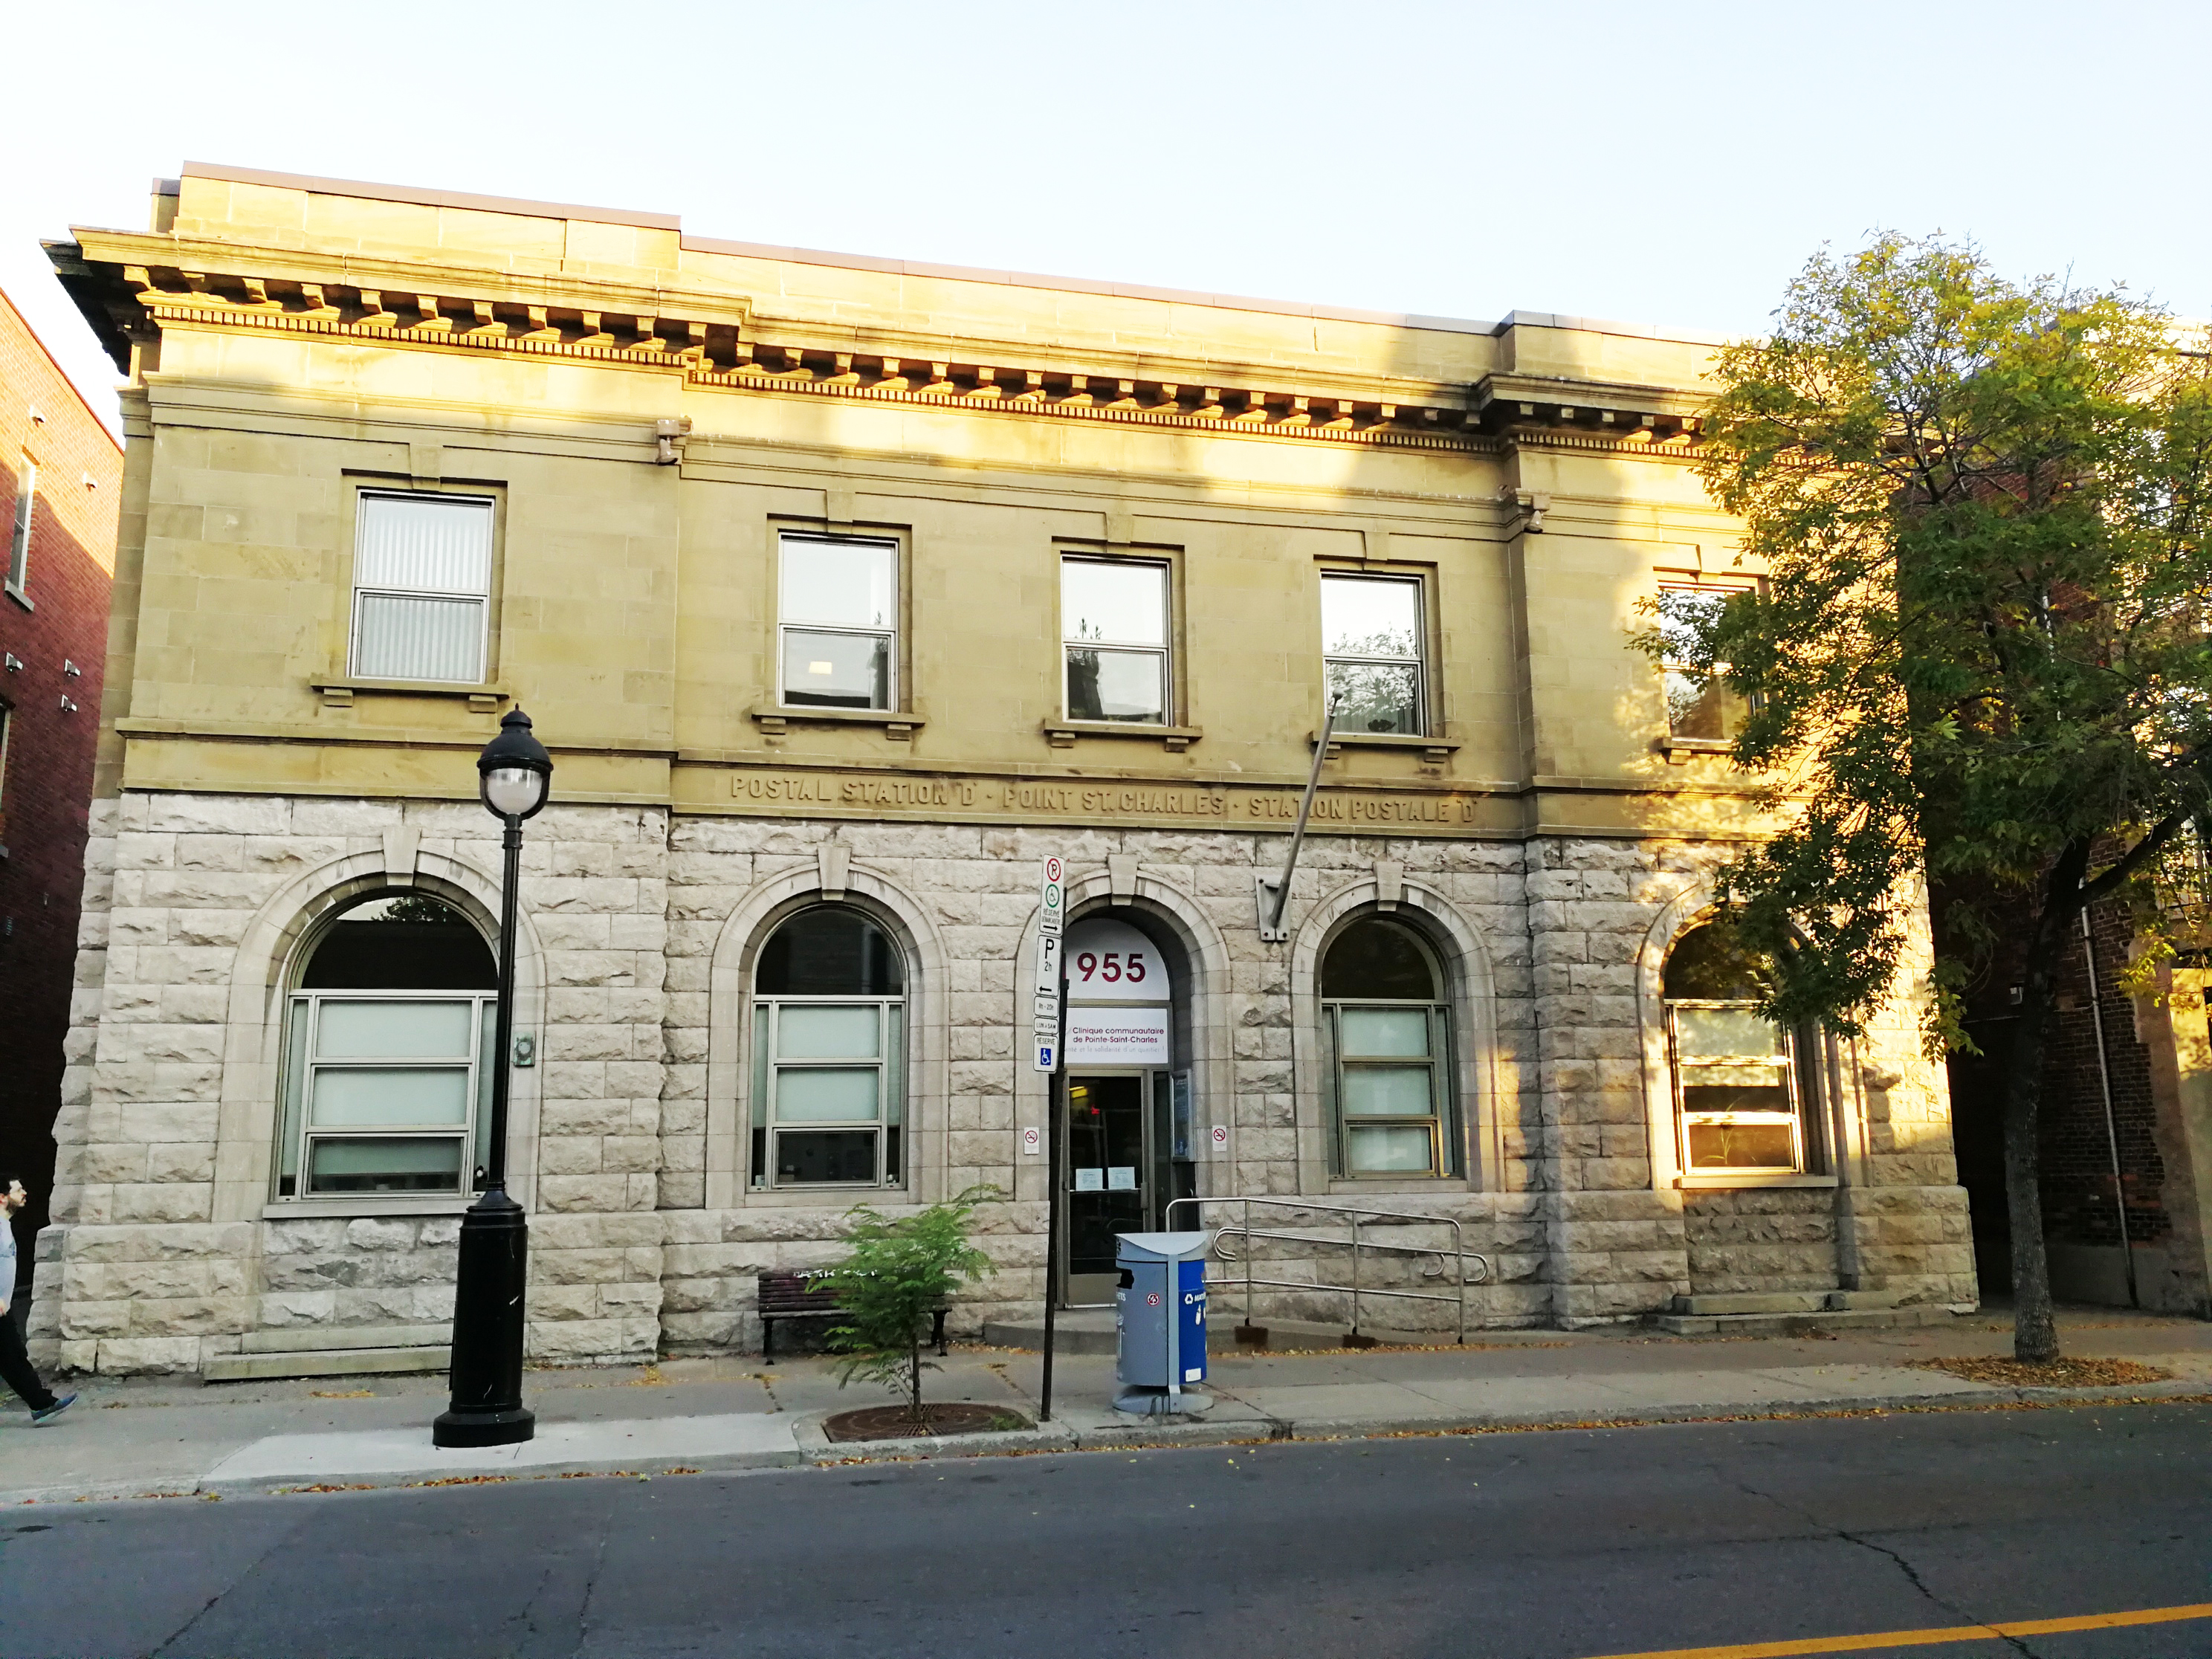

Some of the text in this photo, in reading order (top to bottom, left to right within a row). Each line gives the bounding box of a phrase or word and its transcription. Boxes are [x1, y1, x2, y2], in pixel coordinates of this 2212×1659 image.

[731, 776, 832, 801] POSTAL
[842, 781, 948, 804] STATION
[1003, 786, 1072, 810] POINT
[1120, 792, 1224, 815] CHARLES
[1249, 796, 1343, 819] STATION
[1351, 798, 1450, 821] POSTALE
[1045, 939, 1054, 959] P
[1077, 952, 1146, 983] 955
